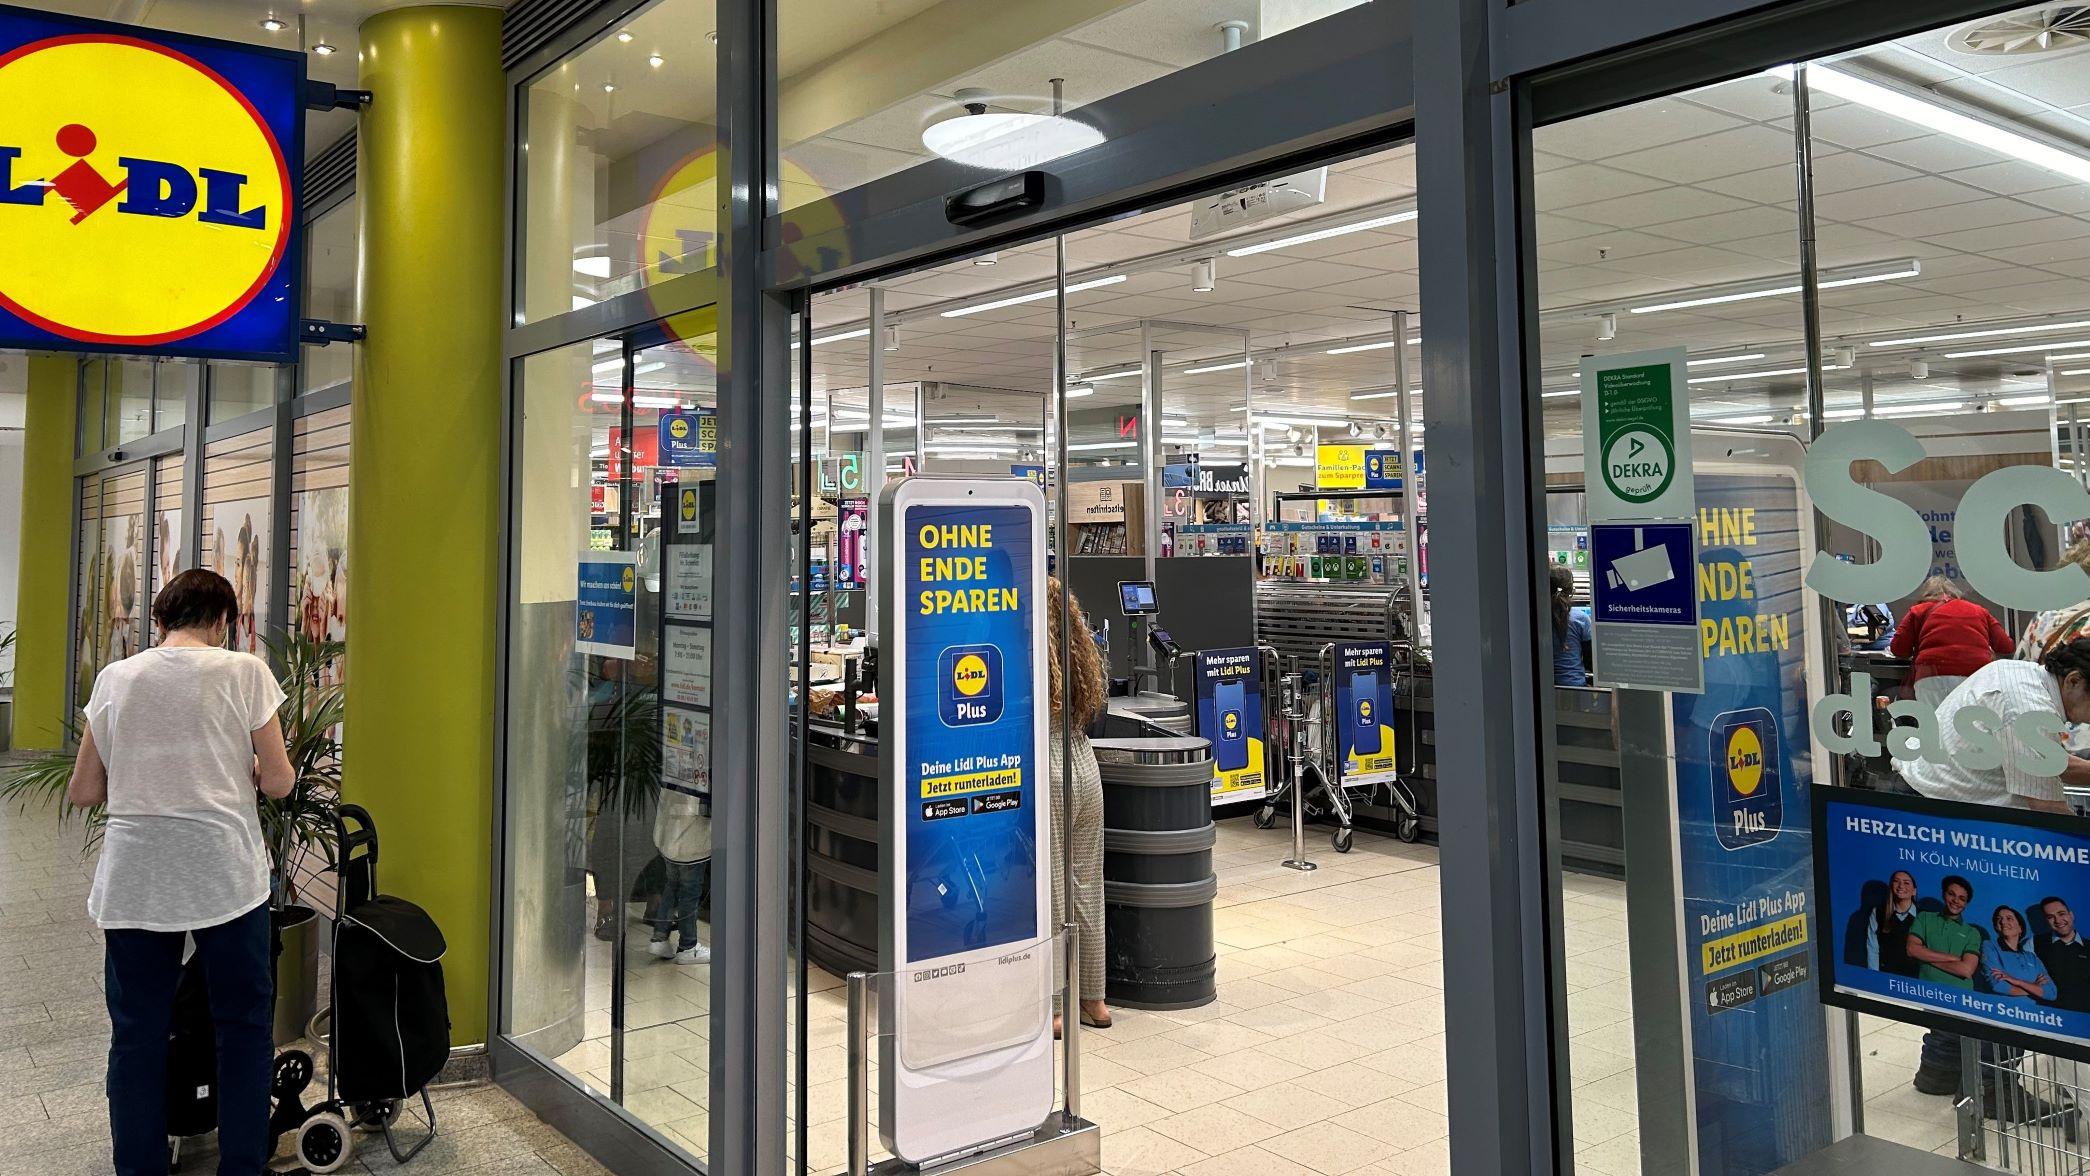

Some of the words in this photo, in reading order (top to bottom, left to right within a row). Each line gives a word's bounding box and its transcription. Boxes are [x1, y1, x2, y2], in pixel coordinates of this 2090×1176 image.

[671, 441, 688, 449] Plus
[1317, 463, 1365, 471] Familien-Pac
[1335, 472, 1364, 481] Sparpre
[1612, 462, 1663, 478] DEKRA
[1625, 483, 1652, 495] geprüft
[919, 524, 993, 549] OHNE
[1697, 507, 1757, 546] HNE
[920, 556, 988, 582] ENDE
[1698, 561, 1754, 601] NDE
[920, 587, 1018, 615] SPAREN
[1607, 604, 1682, 614] Sicherheitskameras
[1700, 612, 1789, 658] PAREN
[1206, 656, 1225, 665] Mehr
[1226, 655, 1250, 665] sparen
[1344, 648, 1361, 656] Mehr
[1361, 647, 1383, 657] sparen
[1345, 659, 1356, 667] mit
[1356, 658, 1369, 667] Lidl
[1369, 657, 1384, 666] Plus
[1207, 667, 1219, 677] mit
[1220, 666, 1234, 675] Lidl
[1235, 665, 1250, 674] Plus
[956, 702, 987, 719] Plus
[1812, 671, 2068, 777] dass
[1226, 731, 1237, 739] Plus
[921, 760, 952, 775] Deine
[954, 757, 973, 772] Lidl
[976, 755, 998, 770] Plus
[1000, 753, 1021, 769] App
[927, 782, 952, 794] Jetzt
[954, 772, 1016, 791] runterladen!
[935, 809, 948, 817] App
[949, 806, 966, 815] Store
[985, 801, 1006, 810] Google
[1006, 799, 1018, 807] Play
[1733, 807, 1766, 836] Plus
[1846, 816, 1945, 844] HERZLICH
[1950, 830, 2090, 865] WILLKOMME
[1899, 847, 1915, 860] IN
[1919, 850, 2040, 881] KÖLN-MÜLHEIM
[1700, 910, 1734, 936] Deine
[1736, 901, 1757, 926] Lidl
[1759, 896, 1782, 919] Plus
[1784, 890, 1805, 913] App
[1708, 943, 1736, 968] Jetzt
[1738, 919, 1803, 958] runterladen!
[998, 953, 1031, 965] lidlplus.de
[1774, 971, 1795, 985] Google
[1795, 966, 1807, 978] Play
[1720, 992, 1735, 1006] App
[1735, 984, 1753, 998] Store
[1889, 979, 1958, 1004] Filialleiter
[1962, 994, 1994, 1013] Herr
[1997, 1002, 2063, 1027] Schmidt
